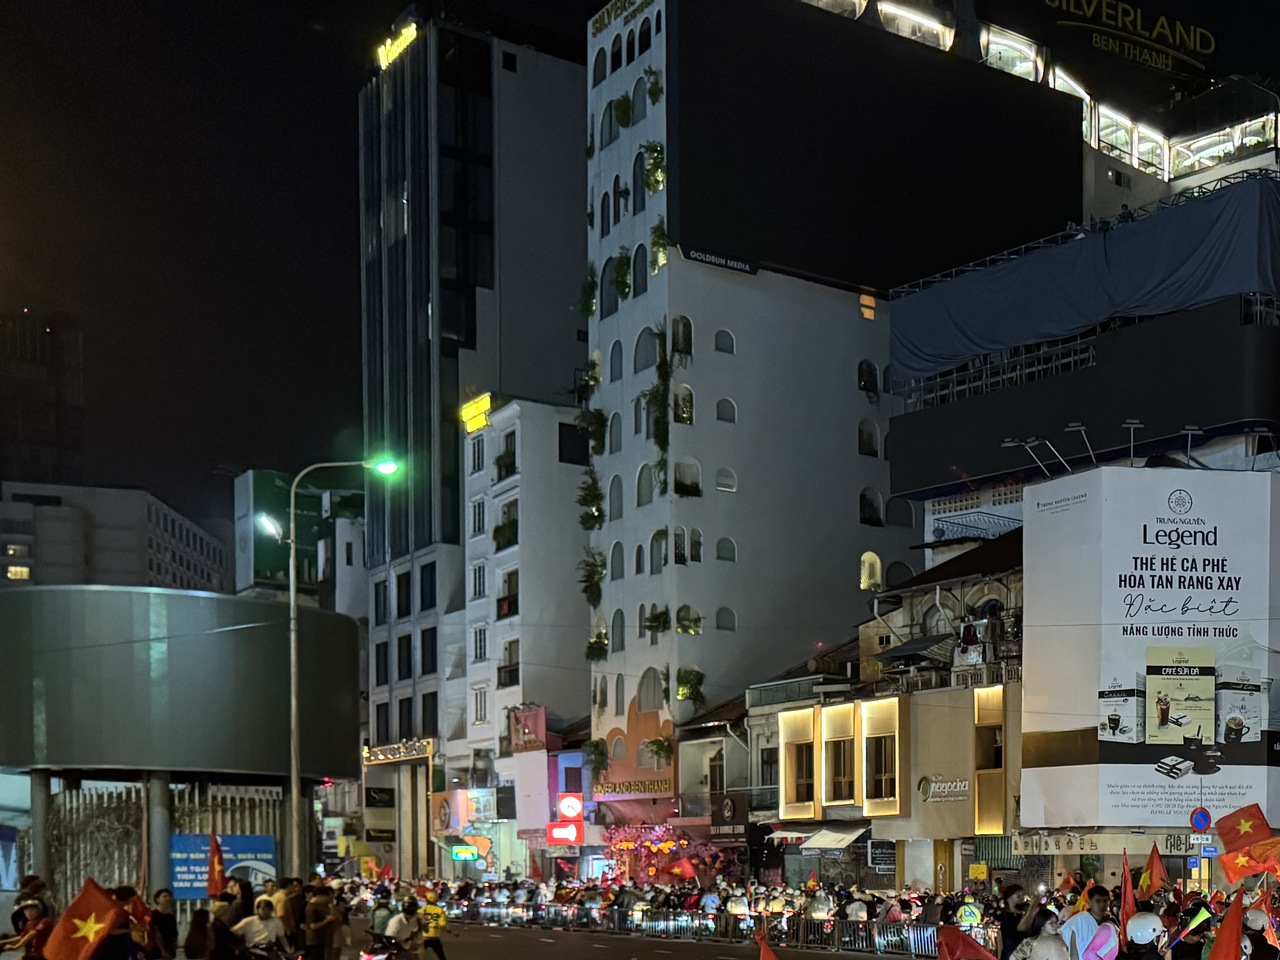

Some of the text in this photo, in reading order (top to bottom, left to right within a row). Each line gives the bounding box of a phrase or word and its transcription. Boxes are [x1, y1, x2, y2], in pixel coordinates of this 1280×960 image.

[1092, 33, 1173, 71] BEN THANH
[690, 250, 751, 272] GOLDSUN MEDIA
[1156, 517, 1206, 526] TRUNG NGUYÊN
[1142, 524, 1218, 550] Legend
[1132, 554, 1156, 571] THẾ
[1181, 555, 1198, 572] CÀ
[1202, 556, 1228, 573] PHÊ
[1118, 571, 1242, 591] HÒA TAN RANG XAY
[1123, 593, 1239, 618] Đặc biệt
[1122, 624, 1148, 636] NĂNG
[1152, 625, 1184, 638] LƯỢNG
[1212, 625, 1238, 638] THỨC
[594, 779, 671, 795] SILVERLAND BEN THANH
